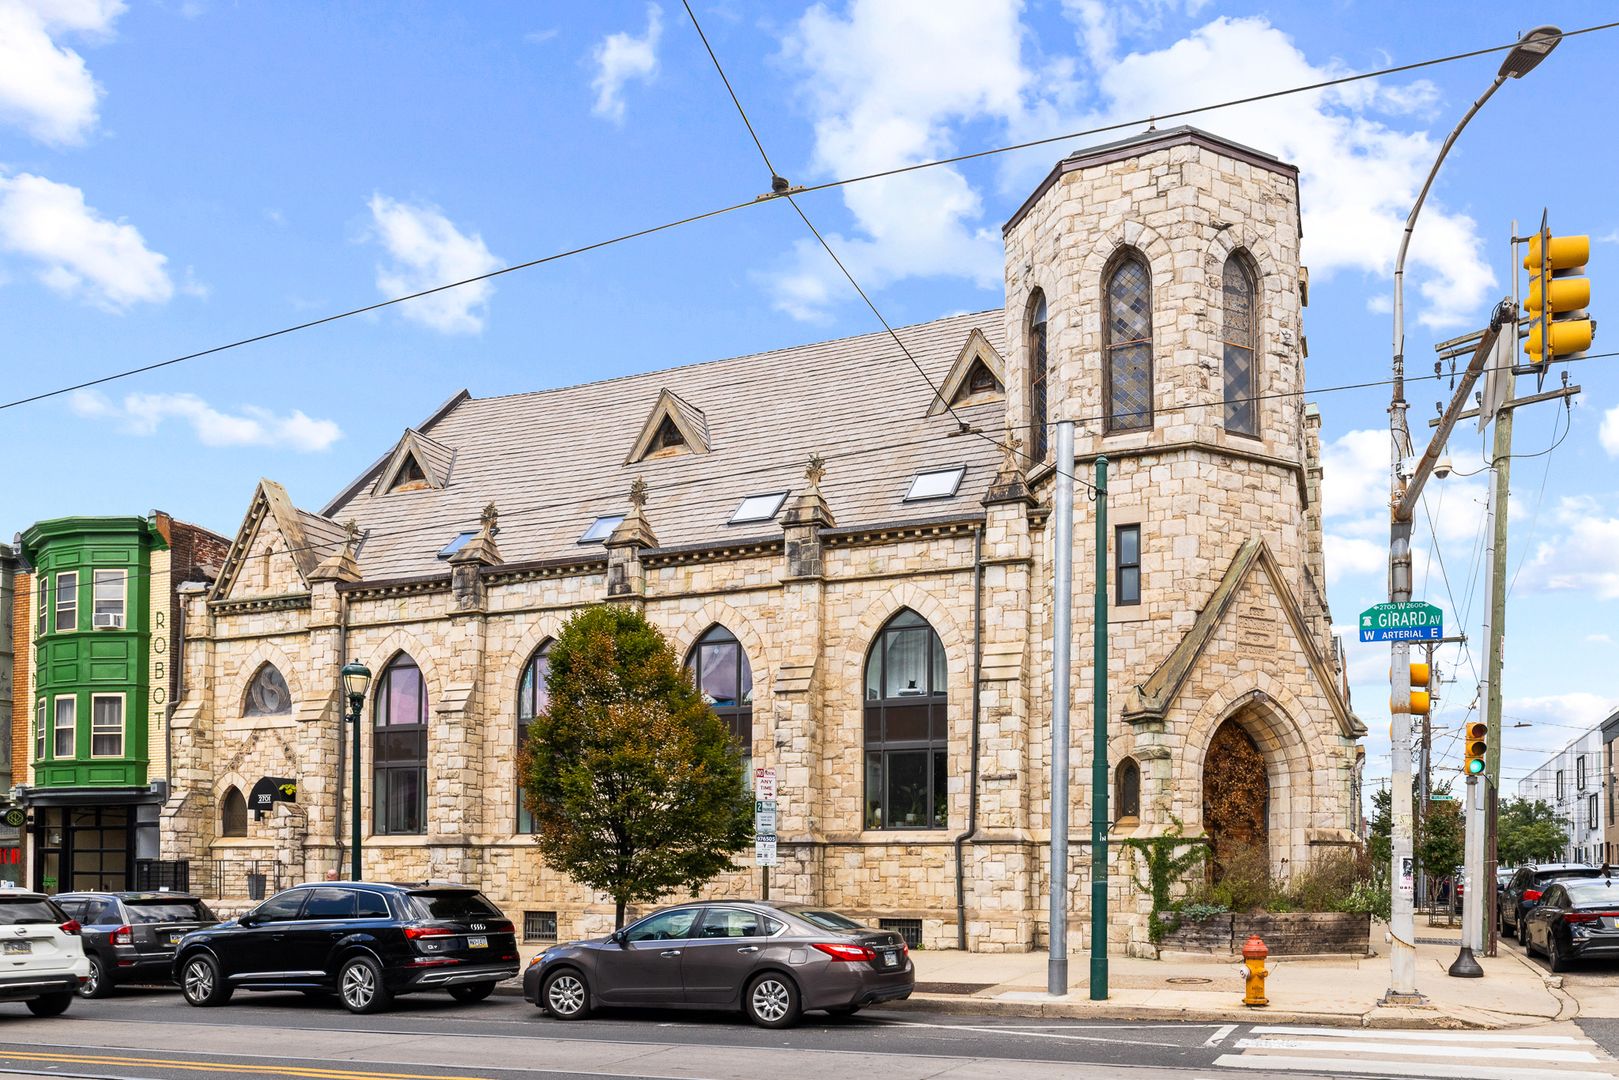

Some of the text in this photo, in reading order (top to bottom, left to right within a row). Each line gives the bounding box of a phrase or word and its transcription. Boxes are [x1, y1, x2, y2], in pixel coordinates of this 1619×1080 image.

[1397, 602, 1406, 610] W
[1378, 611, 1441, 627] GIRARD AV
[1364, 628, 1438, 640] W ARTERIAL E
[153, 612, 166, 731] ROBOT
[757, 802, 762, 812] 2
